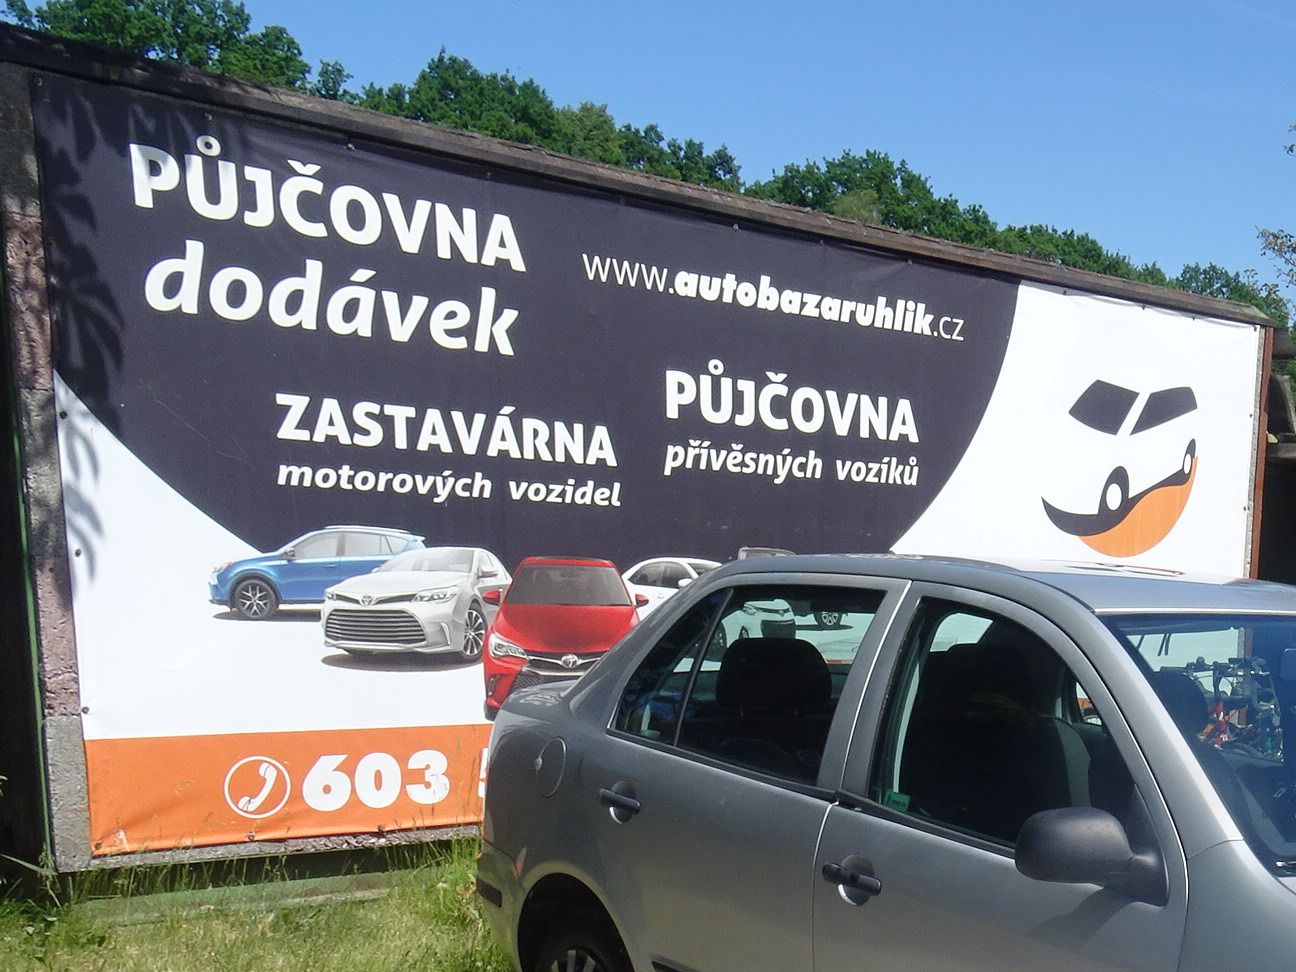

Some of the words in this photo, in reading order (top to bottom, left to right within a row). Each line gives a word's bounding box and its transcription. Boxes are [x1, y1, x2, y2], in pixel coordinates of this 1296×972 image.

[129, 135, 527, 272] PŮJČOVNA
[144, 239, 519, 356] dodávek
[582, 252, 965, 341] www.autobazaruhlik.cz
[275, 392, 618, 467] ZASTAVÁRNA
[665, 358, 920, 444] PŮJČOVNA
[277, 463, 492, 504] motorových
[508, 478, 622, 507] vozidel
[663, 439, 823, 485] přívěsných
[835, 455, 919, 486] vozíků
[301, 749, 451, 812] 603
